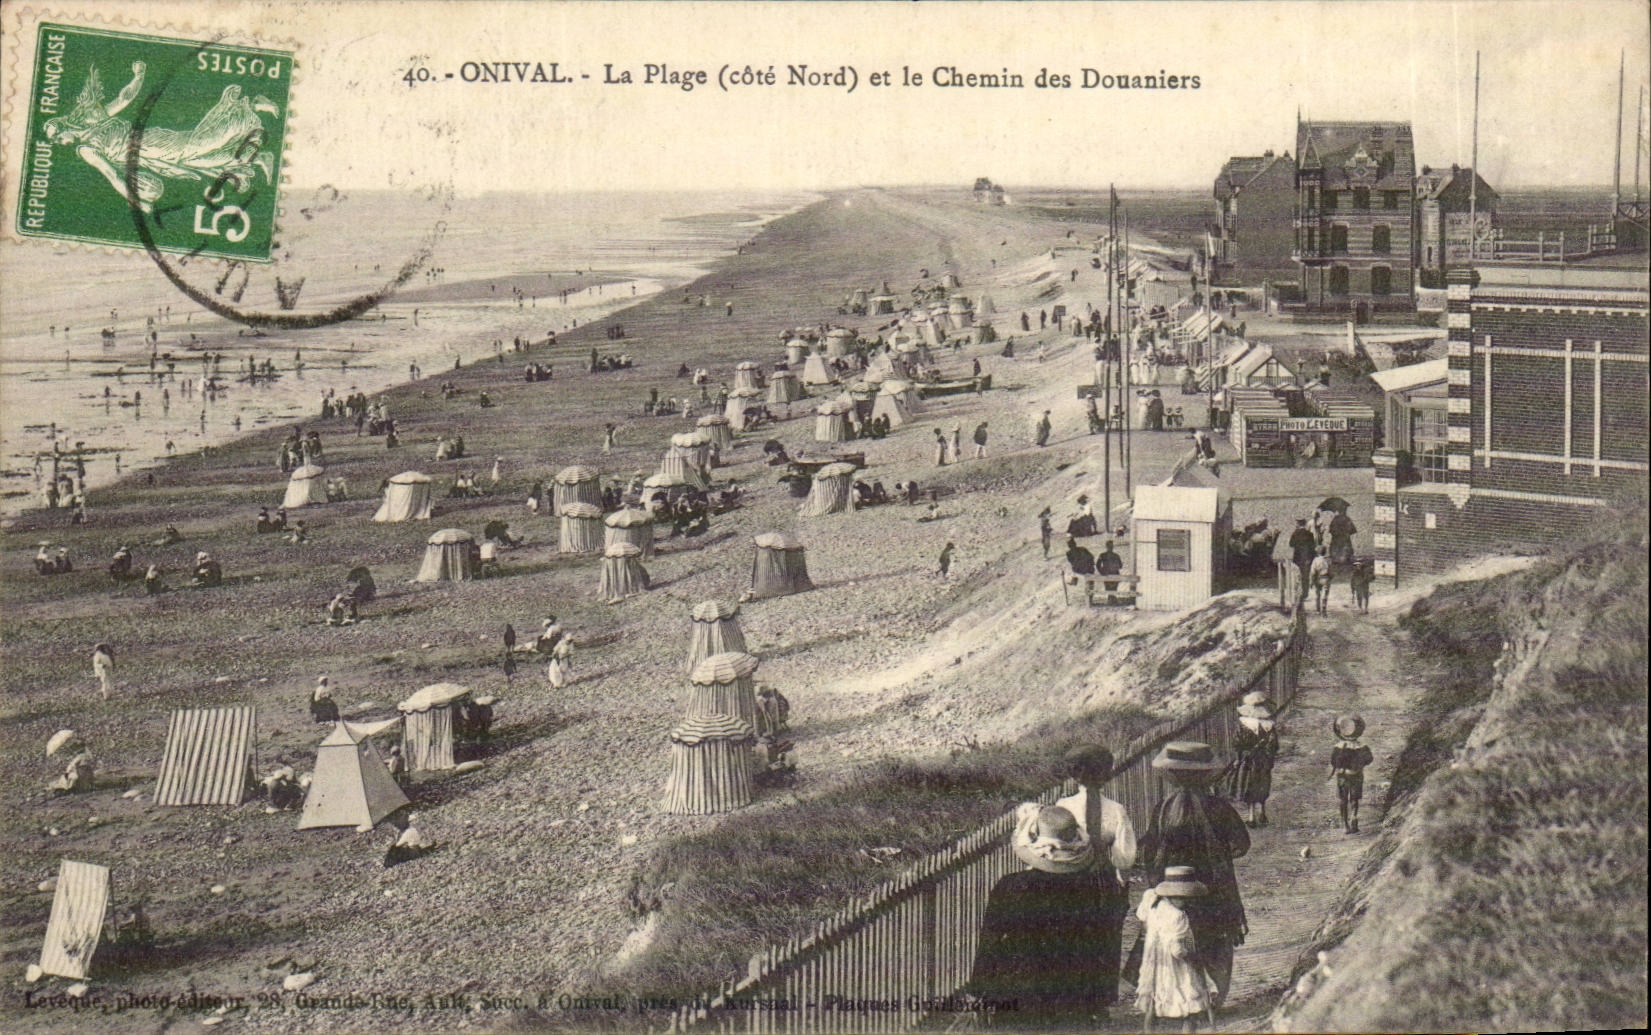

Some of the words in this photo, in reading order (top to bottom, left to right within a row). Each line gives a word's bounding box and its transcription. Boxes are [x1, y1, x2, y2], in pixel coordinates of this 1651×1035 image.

[40, 33, 66, 114] FRANÇAISE
[198, 51, 281, 79] POSTES
[1280, 420, 1305, 430] PHOTO
